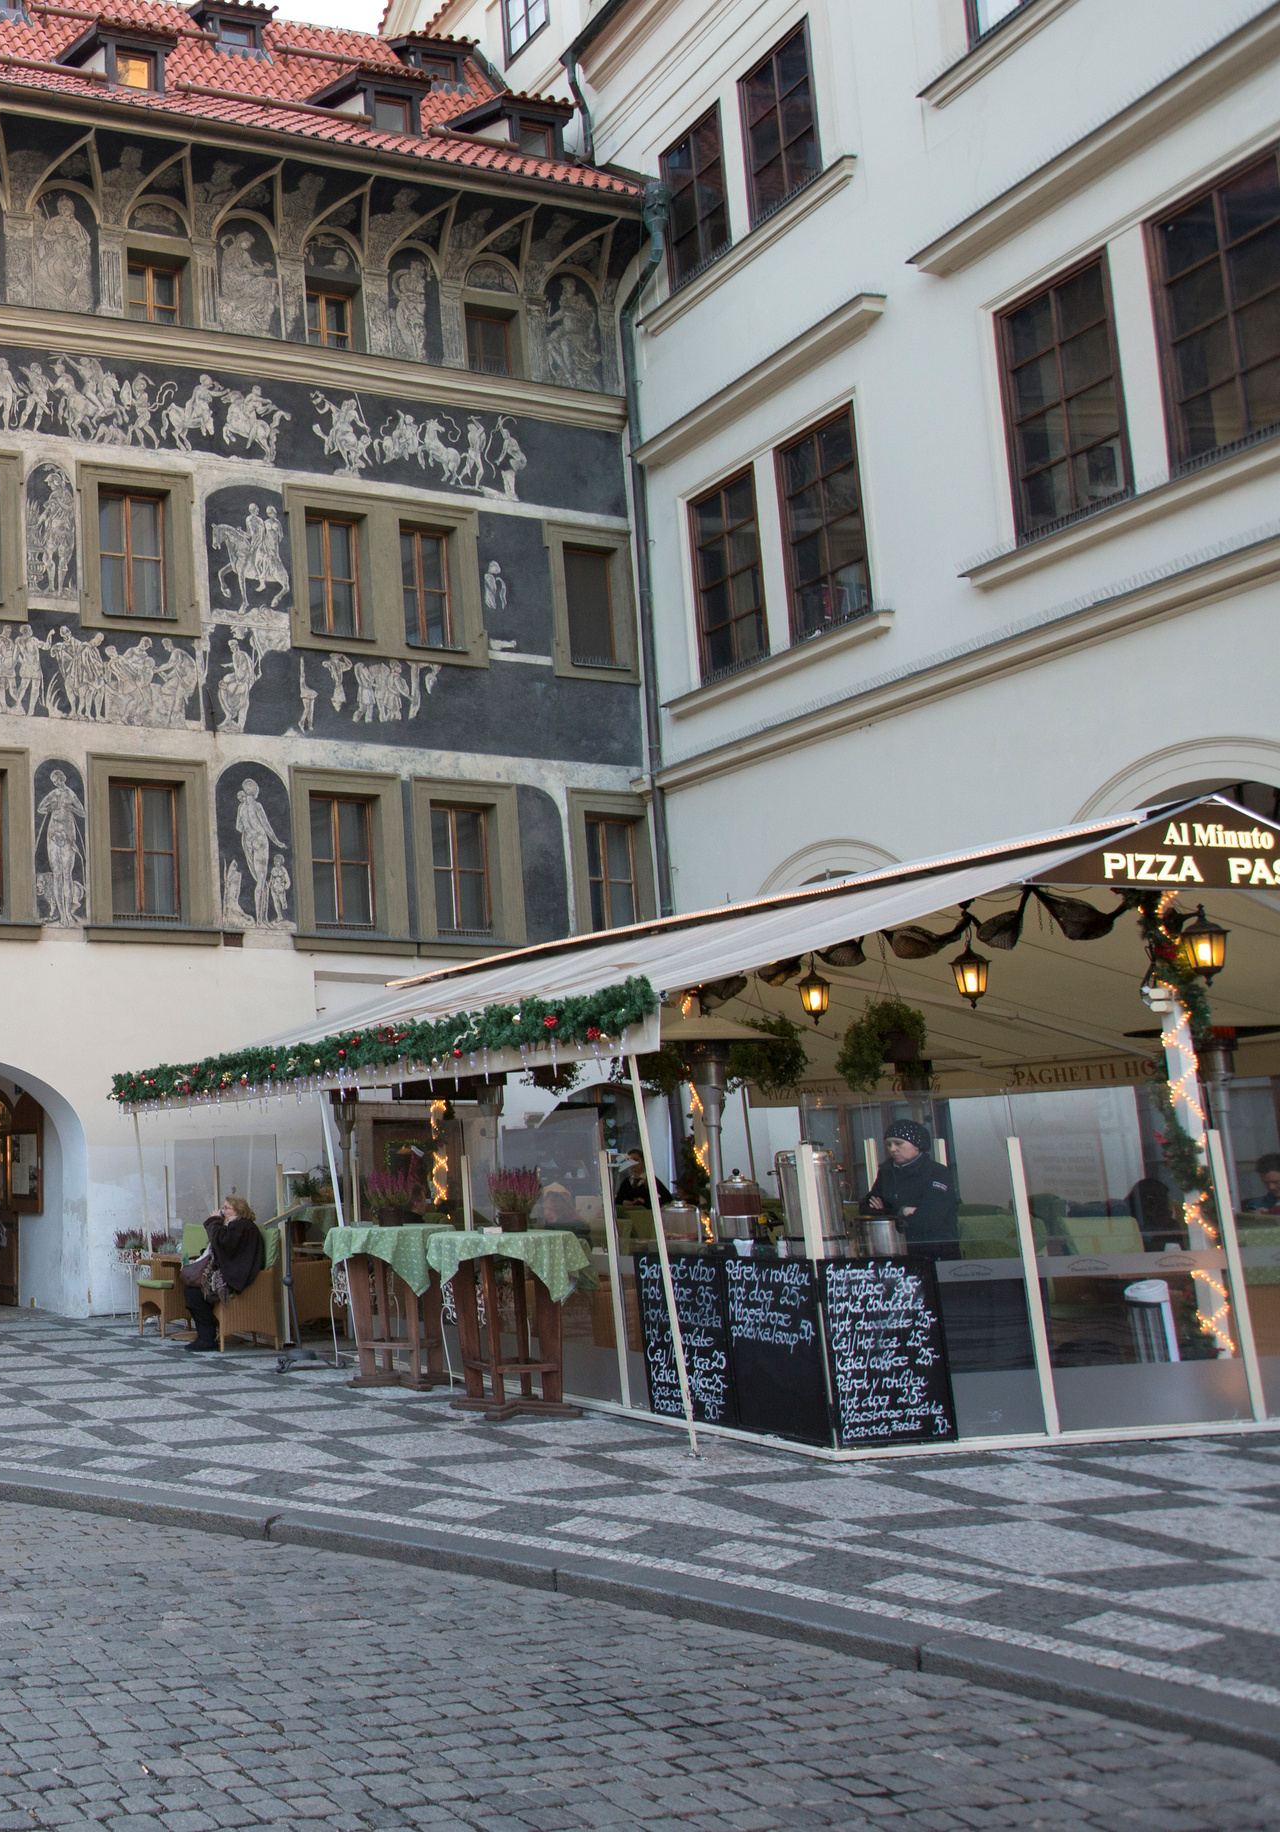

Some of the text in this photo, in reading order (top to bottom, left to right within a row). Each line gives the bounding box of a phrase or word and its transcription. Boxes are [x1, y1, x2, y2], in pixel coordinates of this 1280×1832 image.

[1163, 822, 1275, 850] Al Minuto
[1103, 852, 1204, 883] PIZZA
[1005, 1063, 1116, 1087] SPAGHETTI
[639, 1256, 688, 1280] Svané
[725, 1259, 761, 1281] Párek
[762, 1268, 769, 1282] v
[642, 1280, 662, 1300] Hot
[673, 1282, 693, 1302] ine
[728, 1280, 748, 1300] Hot
[749, 1280, 774, 1310] dog
[827, 1279, 848, 1297] Hot
[851, 1280, 885, 1297] wine
[827, 1295, 864, 1315] Horká
[830, 1313, 852, 1333] Hot
[855, 1312, 913, 1330] chocolate
[645, 1322, 714, 1347] Hot ccolate
[835, 1371, 871, 1393] Párek
[872, 1377, 879, 1389] v
[839, 1390, 859, 1410] Hot
[861, 1388, 890, 1411] dog
